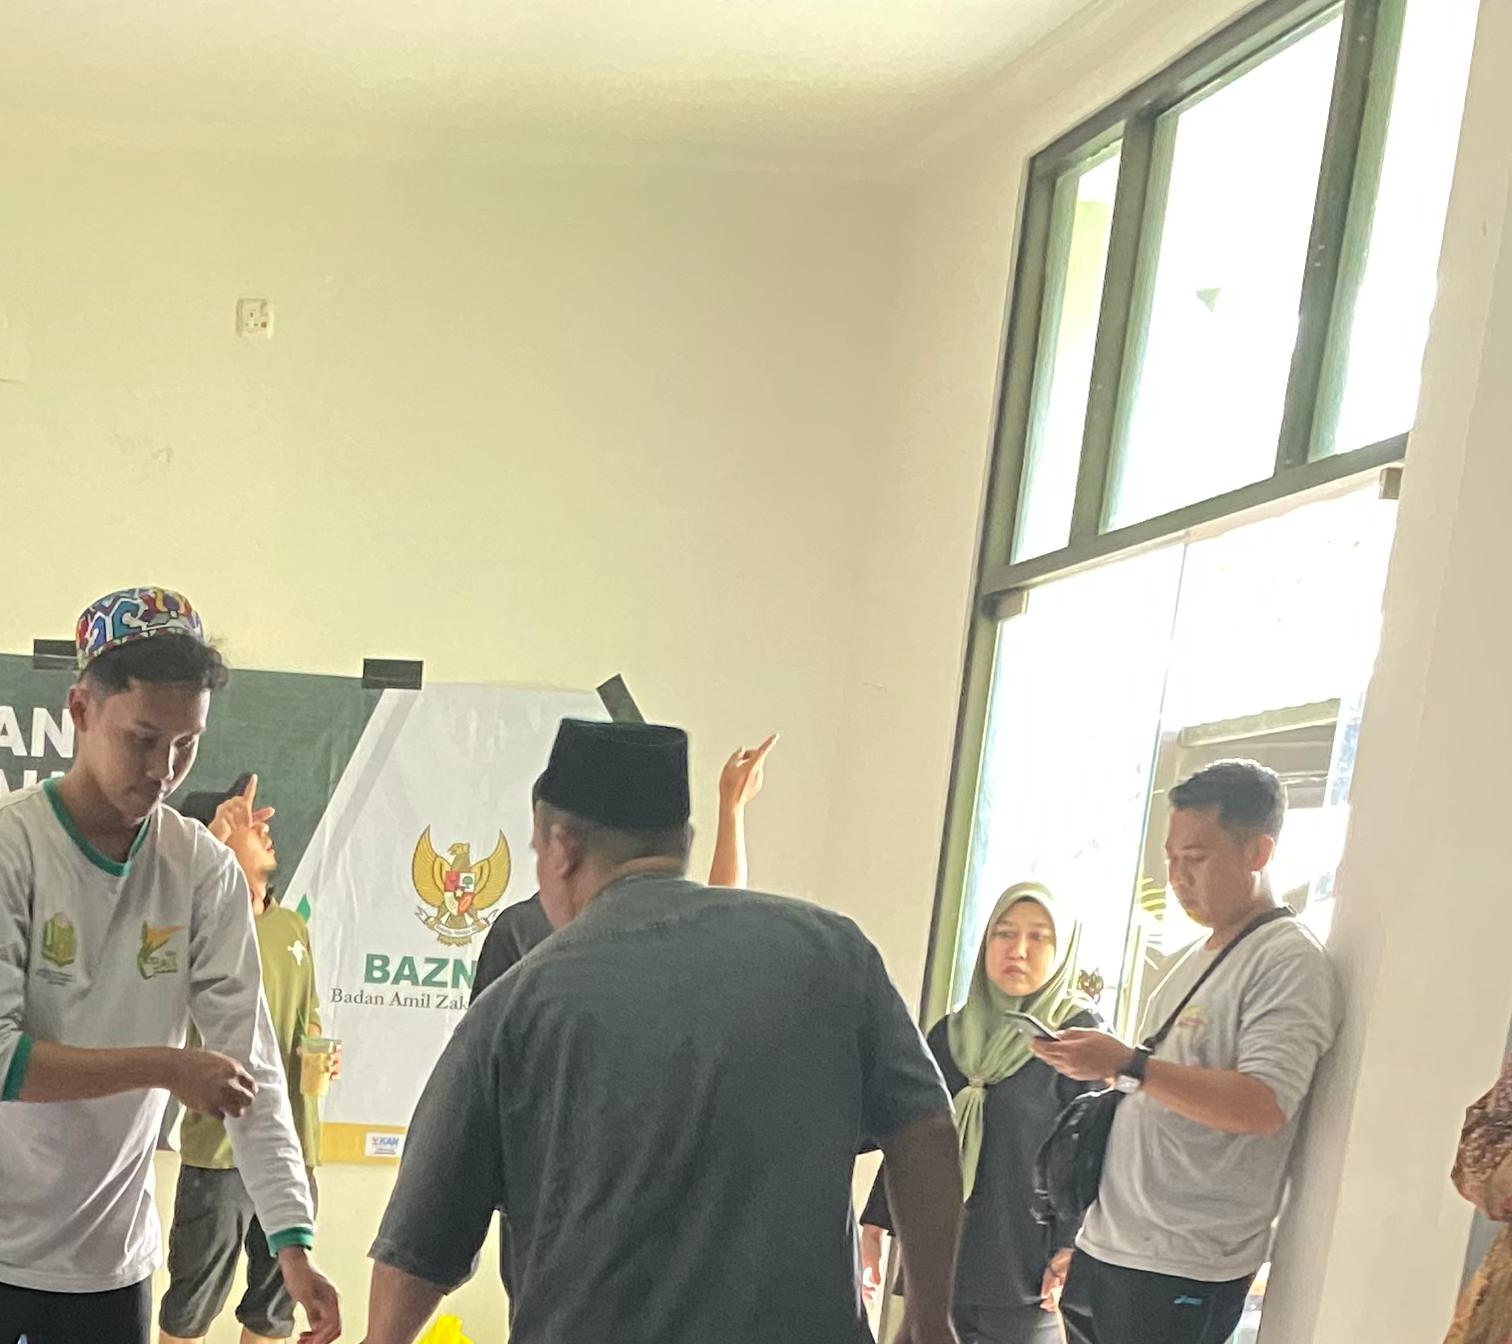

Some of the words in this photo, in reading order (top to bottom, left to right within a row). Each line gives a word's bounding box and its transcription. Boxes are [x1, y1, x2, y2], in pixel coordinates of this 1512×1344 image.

[331, 988, 384, 1006] Badan
[388, 991, 431, 1009] Amil
[436, 994, 470, 1011] Zak
